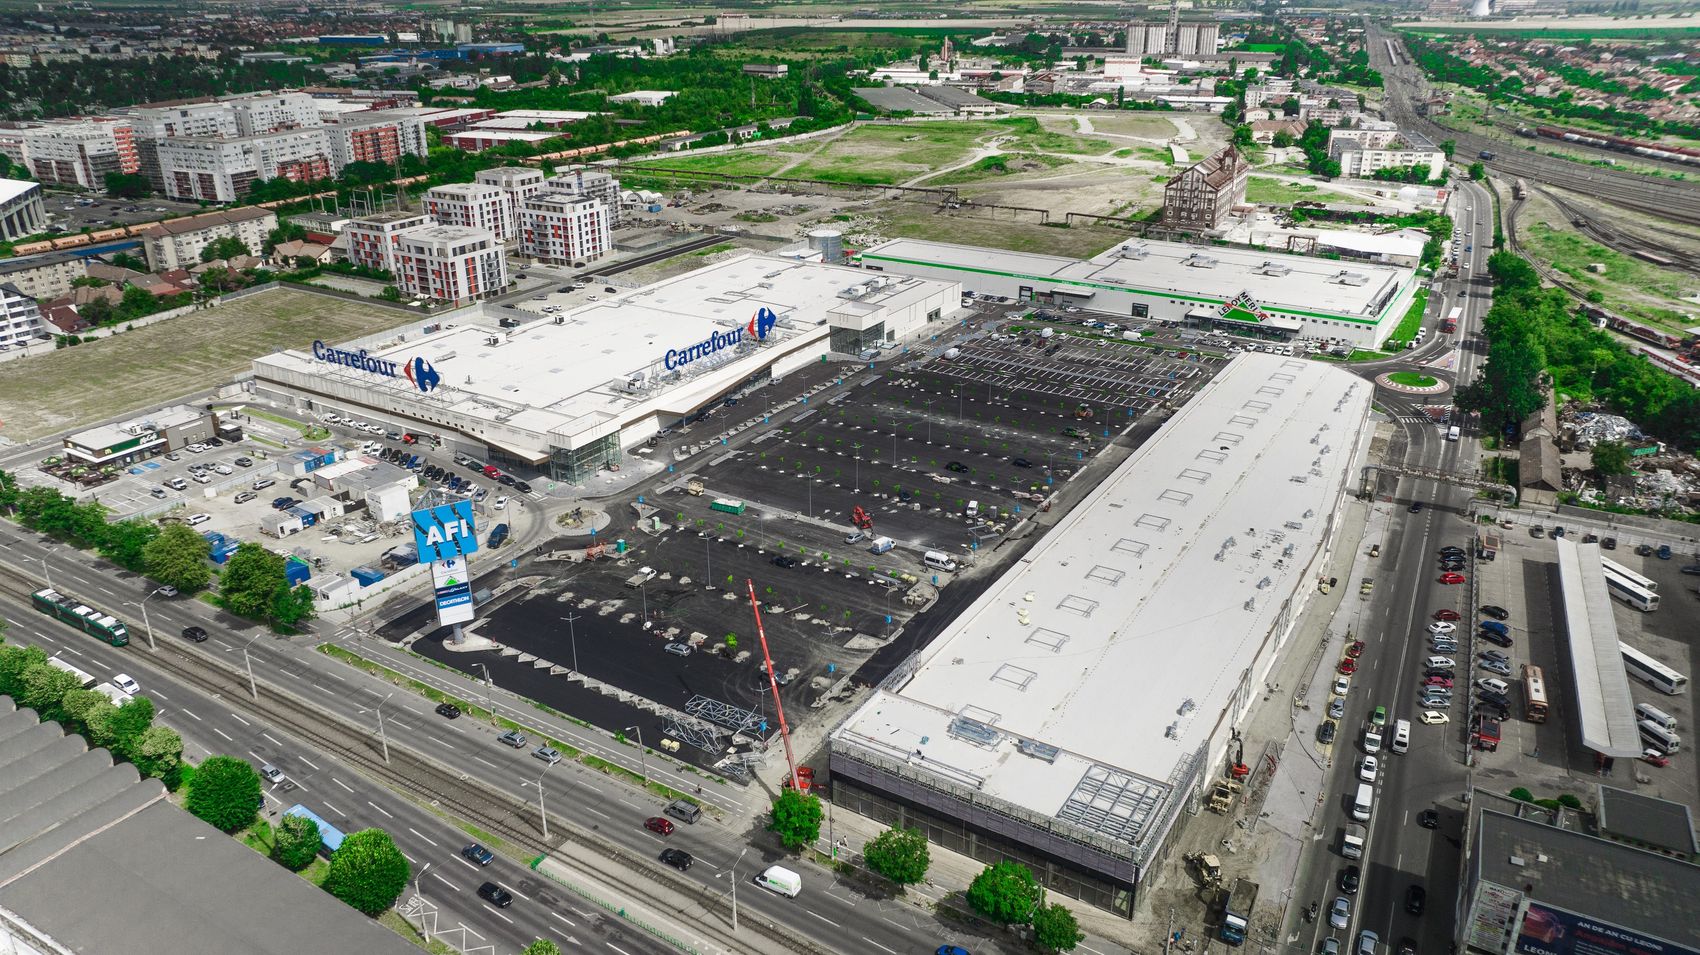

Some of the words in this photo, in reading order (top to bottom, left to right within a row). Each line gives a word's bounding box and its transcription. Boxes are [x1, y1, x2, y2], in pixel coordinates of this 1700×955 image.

[1239, 291, 1267, 322] MERLN
[312, 340, 396, 377] Carrefour
[665, 327, 743, 370] Carrefour
[426, 518, 468, 546] AFI
[1577, 921, 1591, 929] AN
[1591, 925, 1605, 933] DE
[1605, 929, 1619, 937] AN
